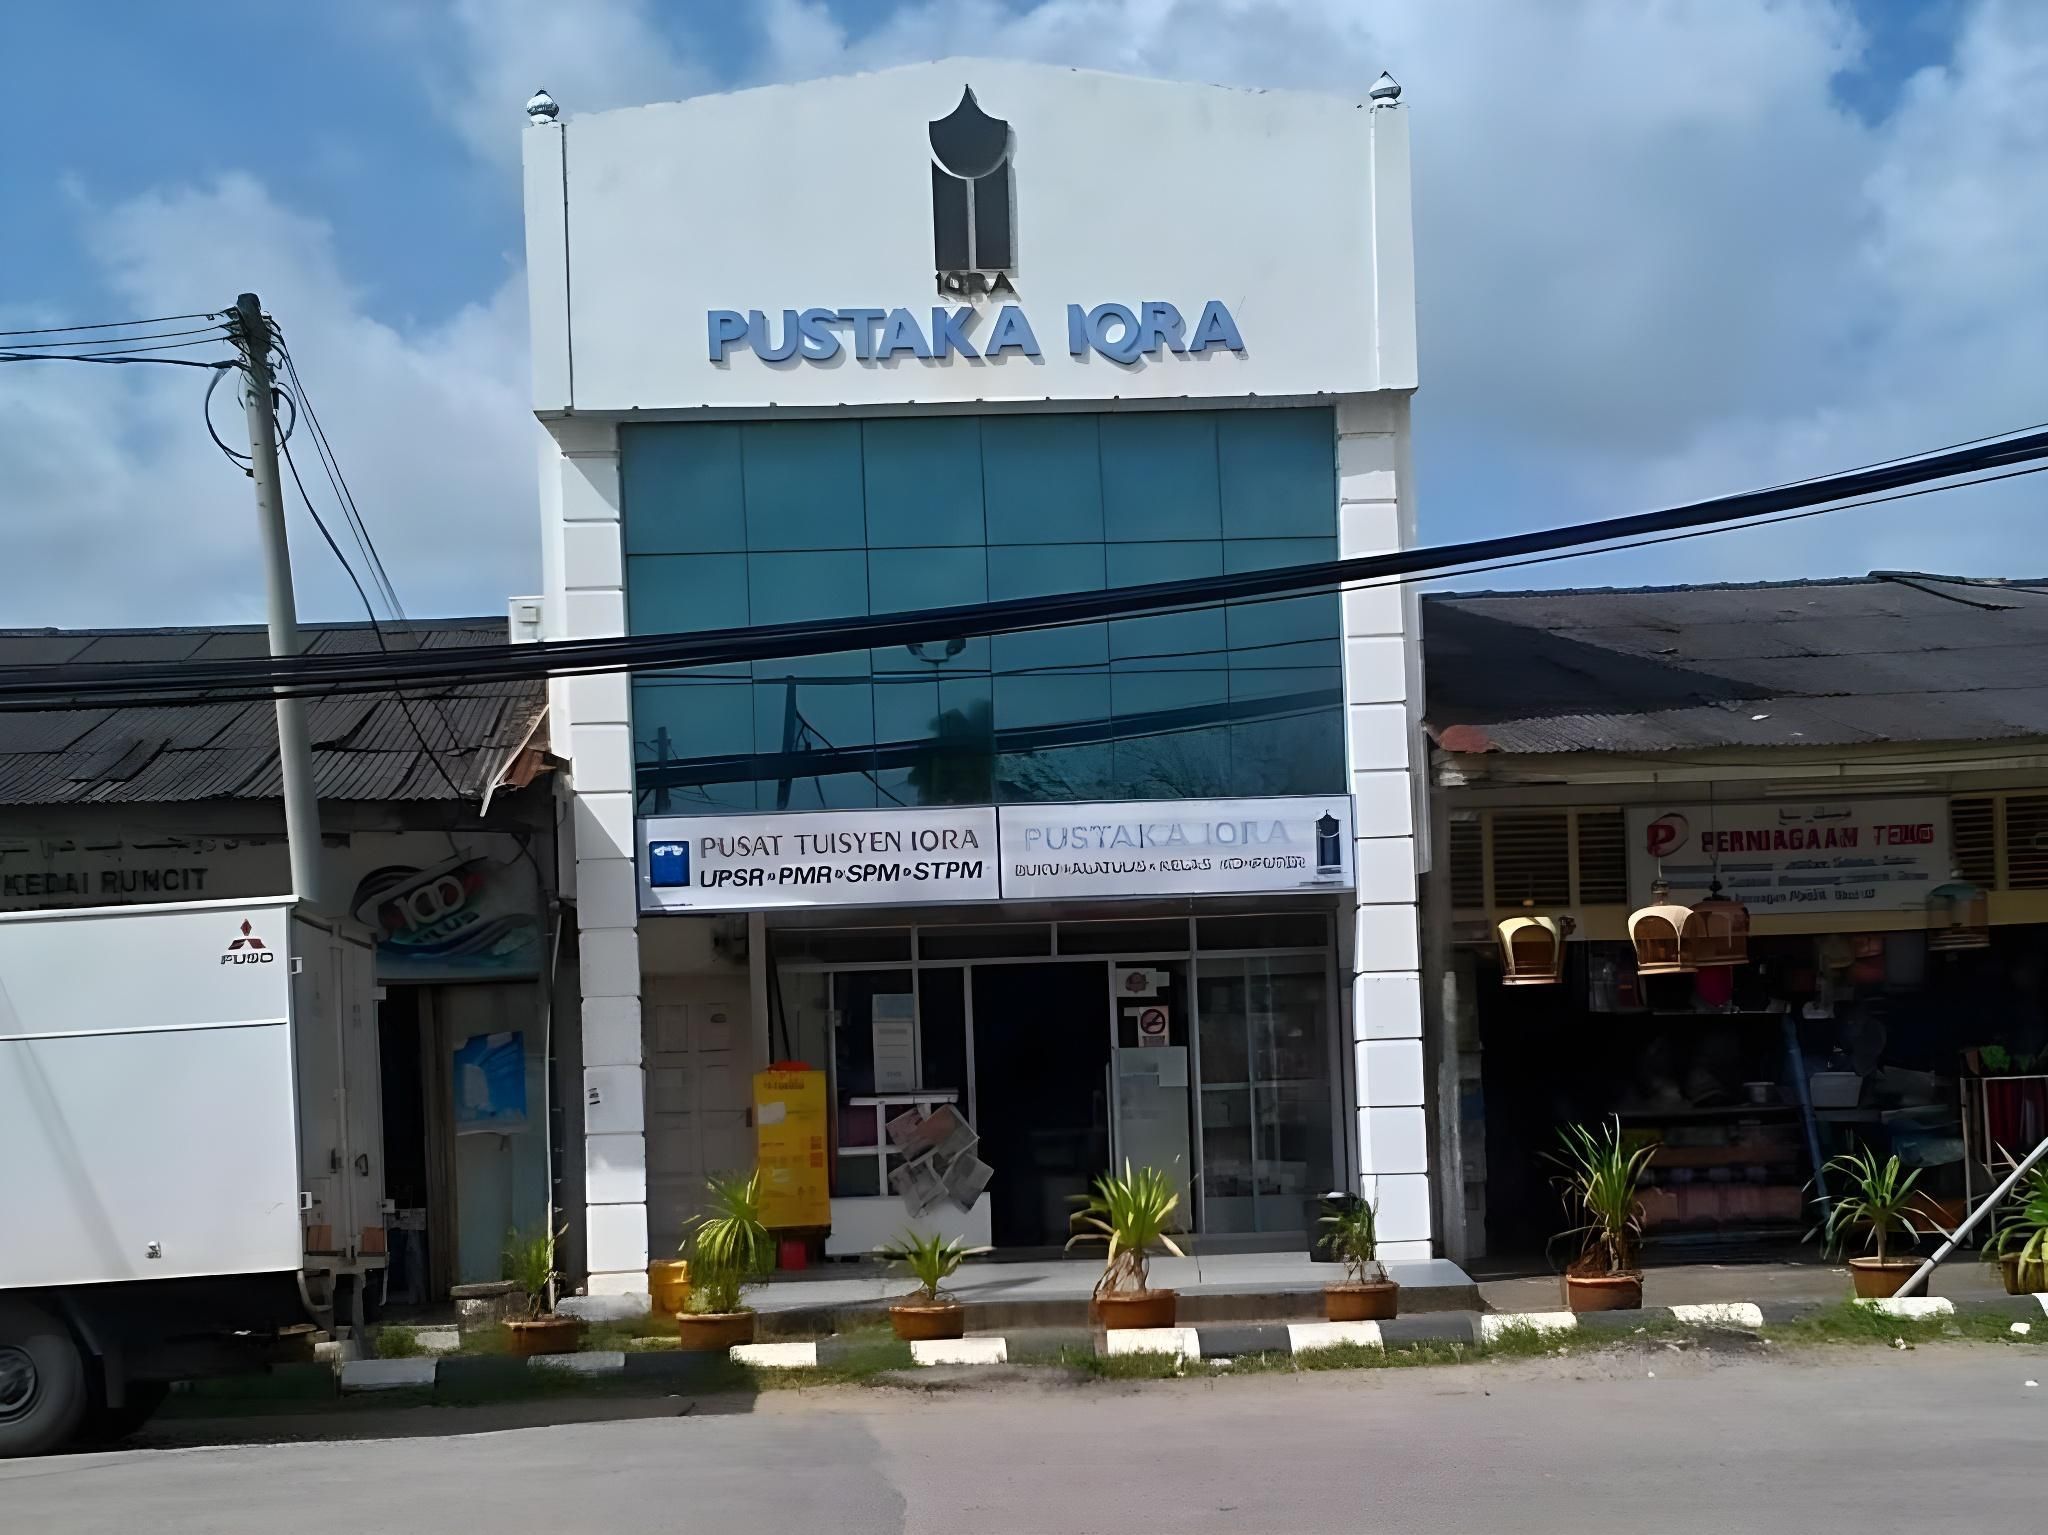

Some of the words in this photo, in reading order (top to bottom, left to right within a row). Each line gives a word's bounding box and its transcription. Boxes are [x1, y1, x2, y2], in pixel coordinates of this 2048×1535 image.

[707, 305, 1041, 366] PUSTAKA
[1067, 299, 1245, 366] IQRA
[700, 834, 783, 859] PUSAT
[794, 830, 902, 856] TUISYEN
[1024, 822, 1189, 852] PUSTAKA
[3, 871, 89, 896] KEDAI
[101, 868, 208, 894] RUNCIT
[699, 867, 765, 888] UPSR
[778, 865, 832, 886] PMR
[845, 862, 901, 884] SPM
[912, 859, 984, 881] STPM
